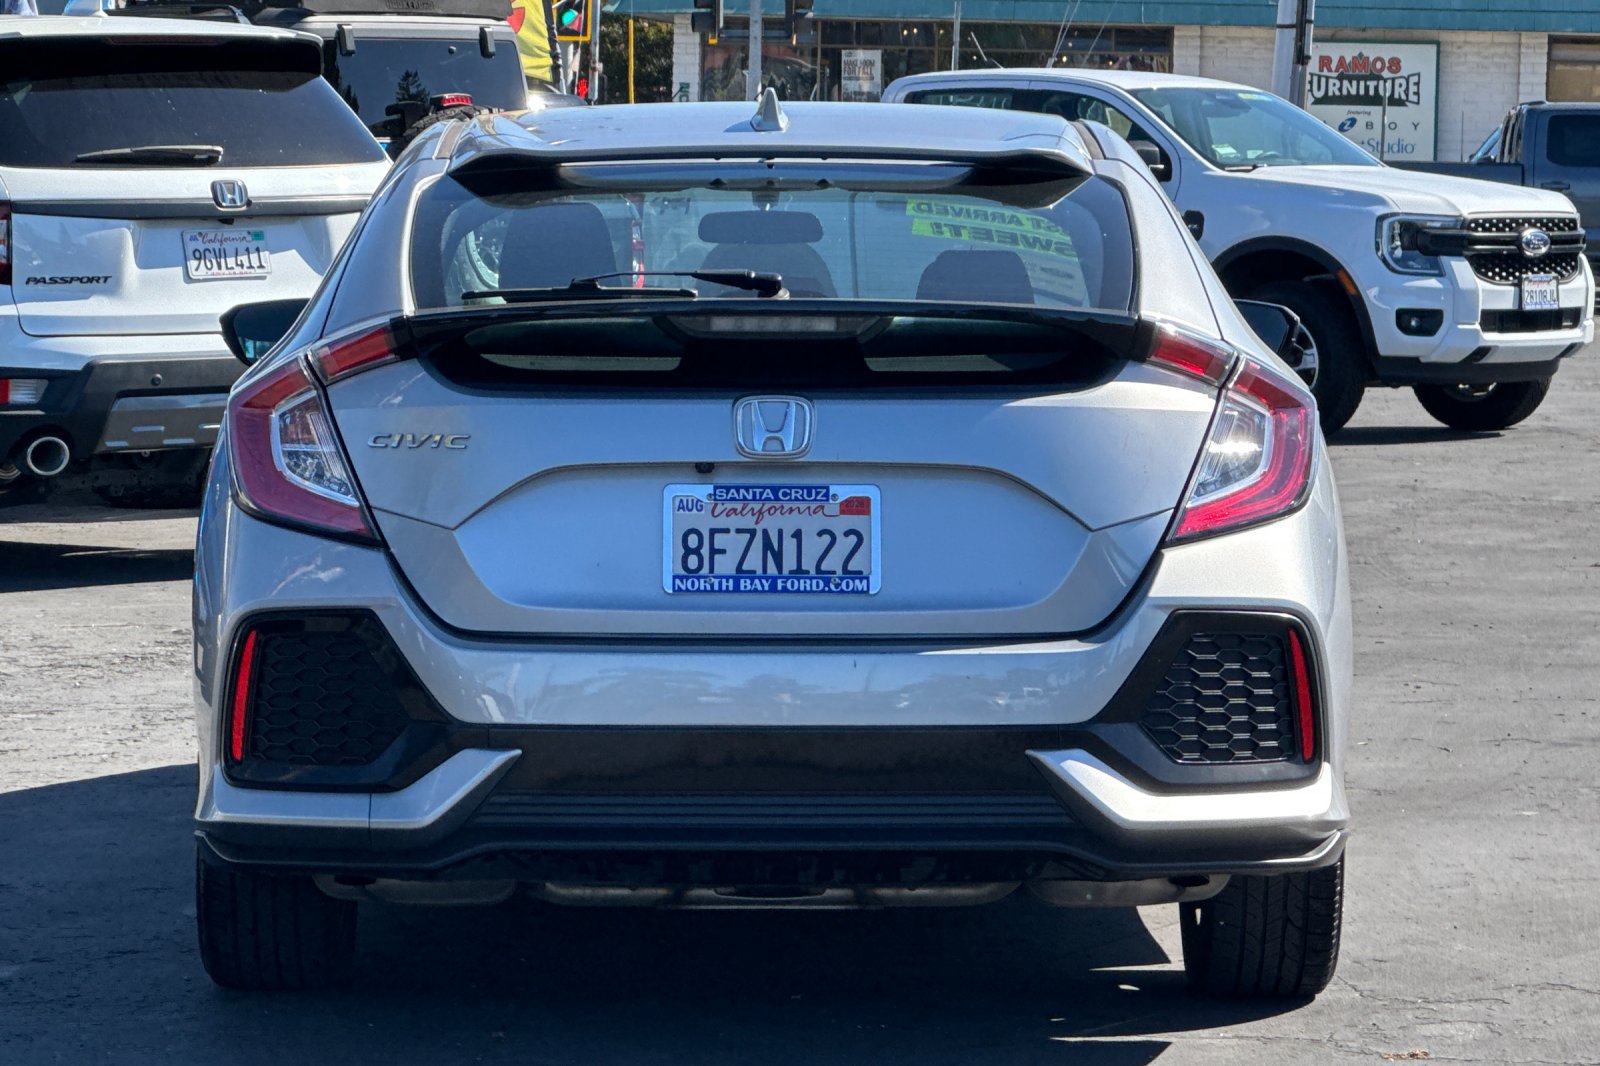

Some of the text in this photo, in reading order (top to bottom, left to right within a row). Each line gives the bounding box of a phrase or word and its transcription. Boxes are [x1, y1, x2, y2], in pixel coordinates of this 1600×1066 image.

[1318, 55, 1402, 74] RAMOS
[1308, 72, 1421, 105] URNITURE
[1367, 138, 1415, 154] Studio
[202, 232, 252, 246] California
[192, 246, 266, 271] 9GVL411
[26, 275, 112, 285] PASSPORT
[367, 433, 471, 449] CIVIC
[715, 488, 827, 500] SANTA CRUZ
[677, 498, 704, 512] AUG
[711, 501, 841, 525] California
[681, 528, 865, 575] 8FZN122
[674, 578, 868, 591] NORTH BAY FORD.COM
